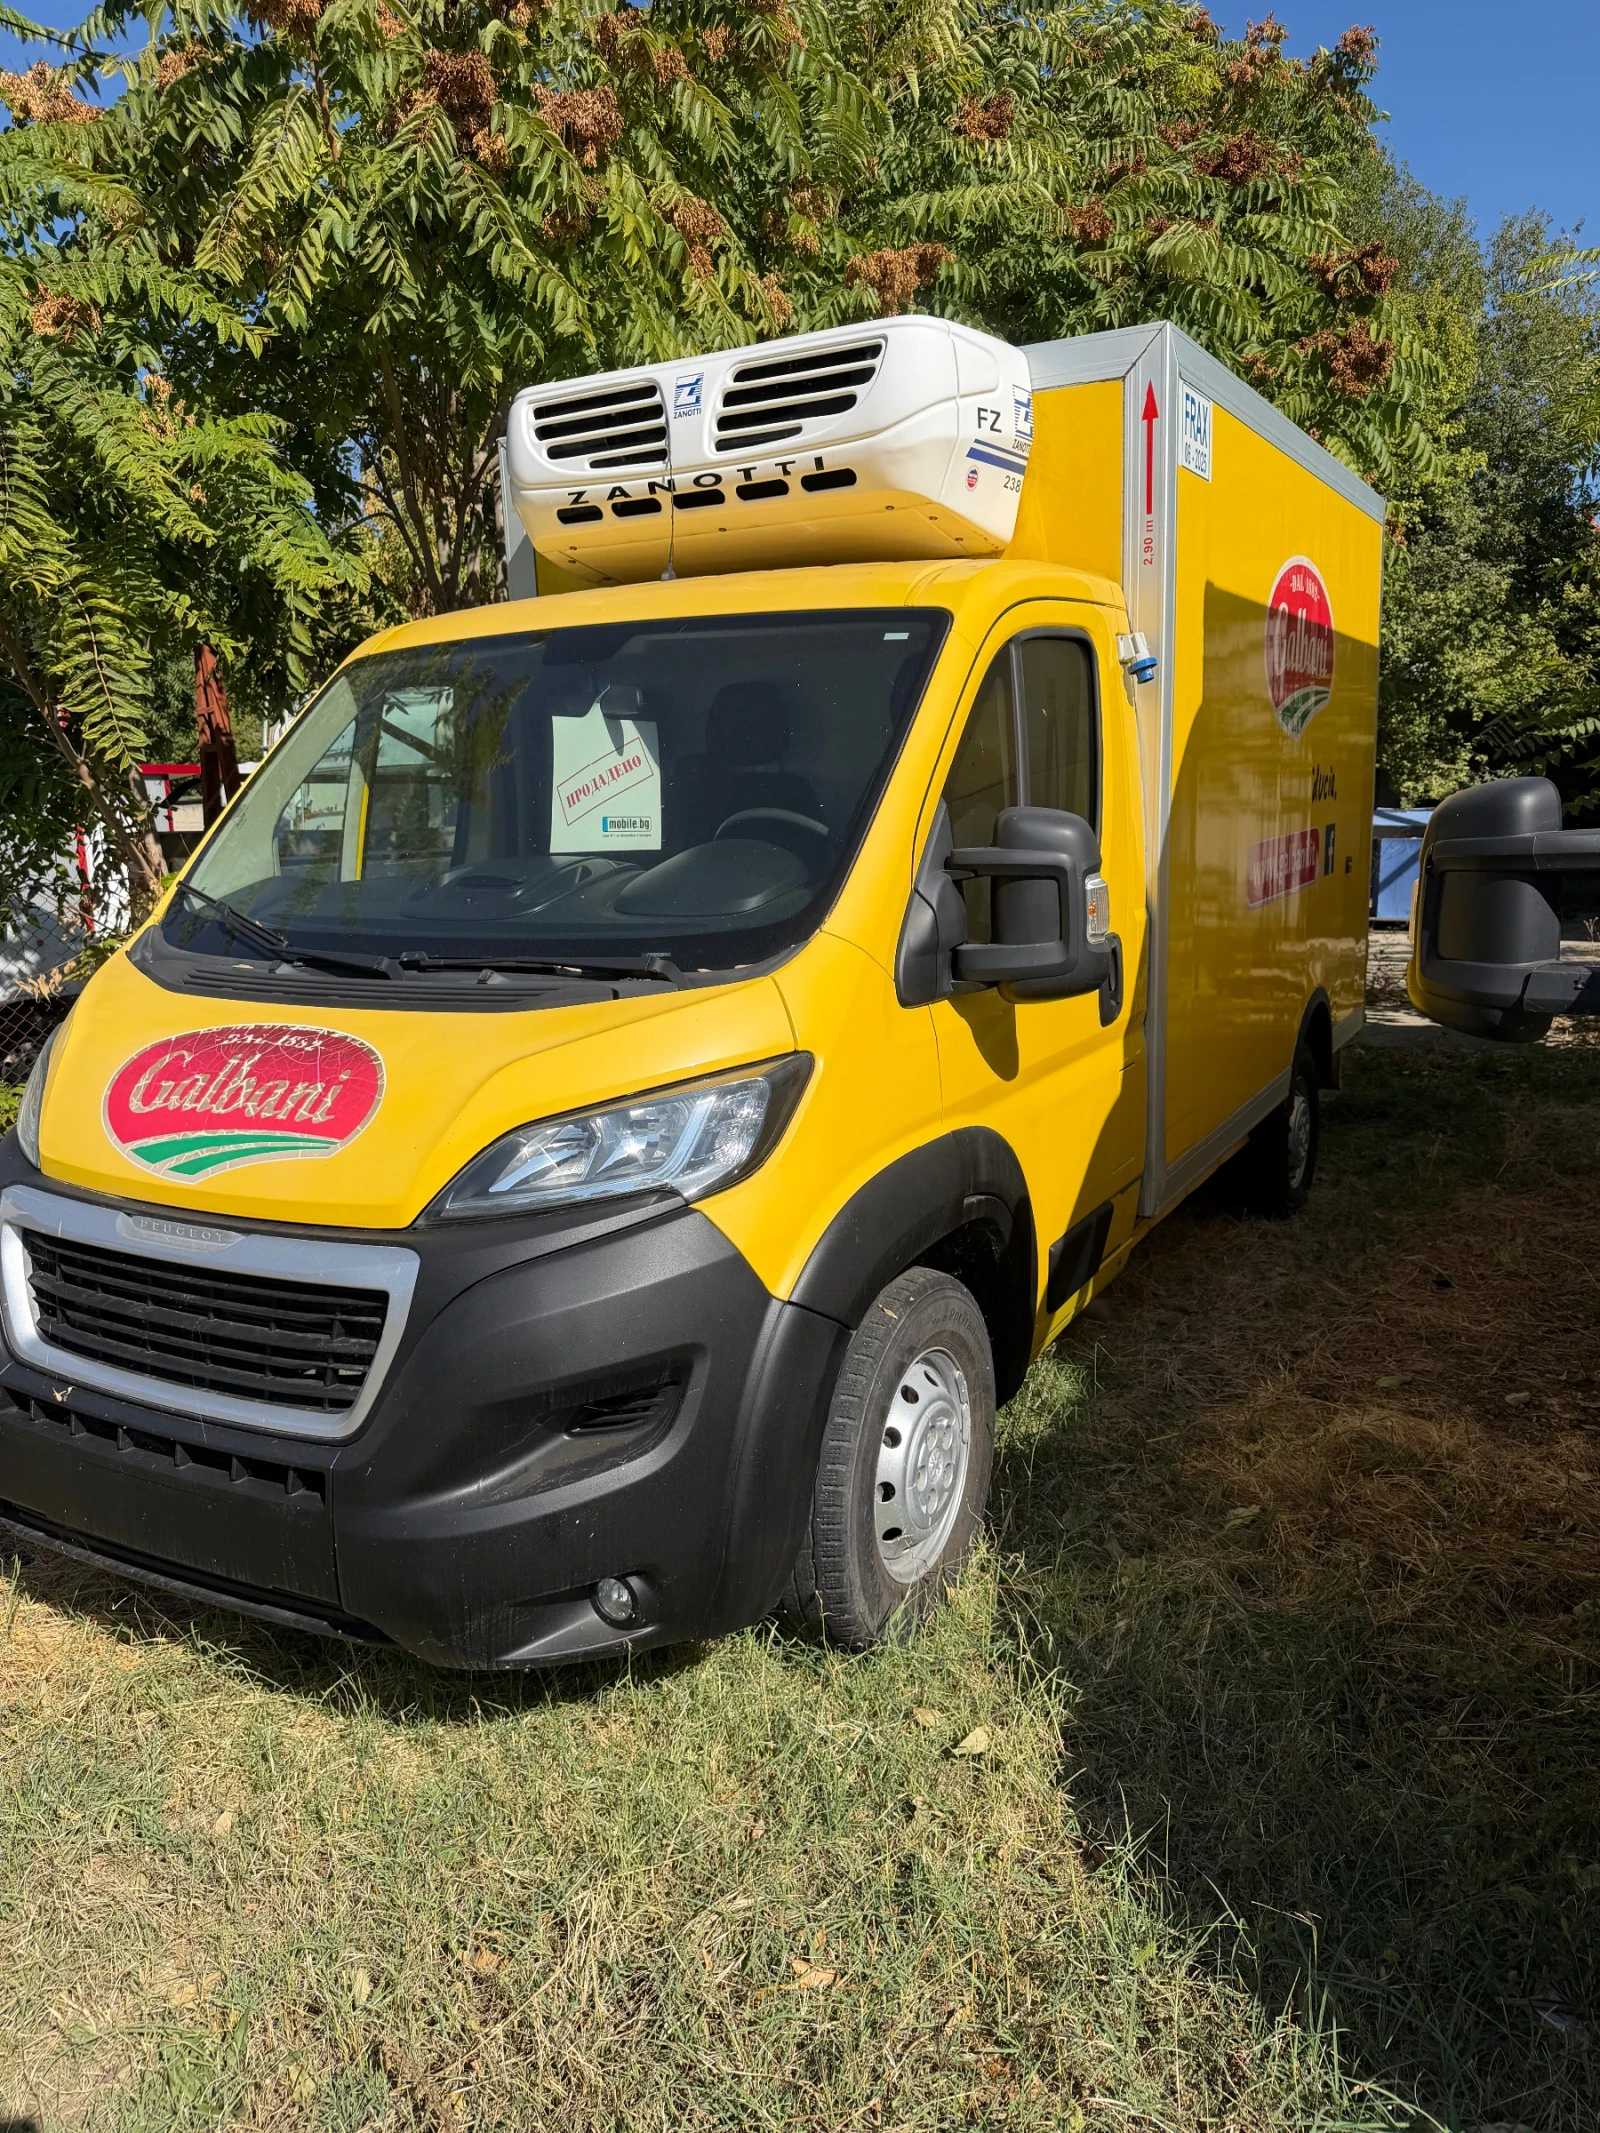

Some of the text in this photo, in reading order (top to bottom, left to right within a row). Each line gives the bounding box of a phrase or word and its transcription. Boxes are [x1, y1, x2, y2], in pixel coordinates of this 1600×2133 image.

[673, 408, 702, 419] ZANOTTI
[977, 407, 1002, 433] FZ
[1184, 391, 1209, 449] FRAX
[567, 456, 825, 506] ZANOTTI
[1003, 475, 1022, 493] 238
[1143, 537, 1155, 566] 2,90
[1273, 601, 1329, 677] Galbani
[566, 755, 642, 809] ПРОДАДЕНО
[609, 818, 650, 830] mobile.bg
[129, 1050, 352, 1124] Galbani
[140, 1219, 225, 1242] PEUGEOT
